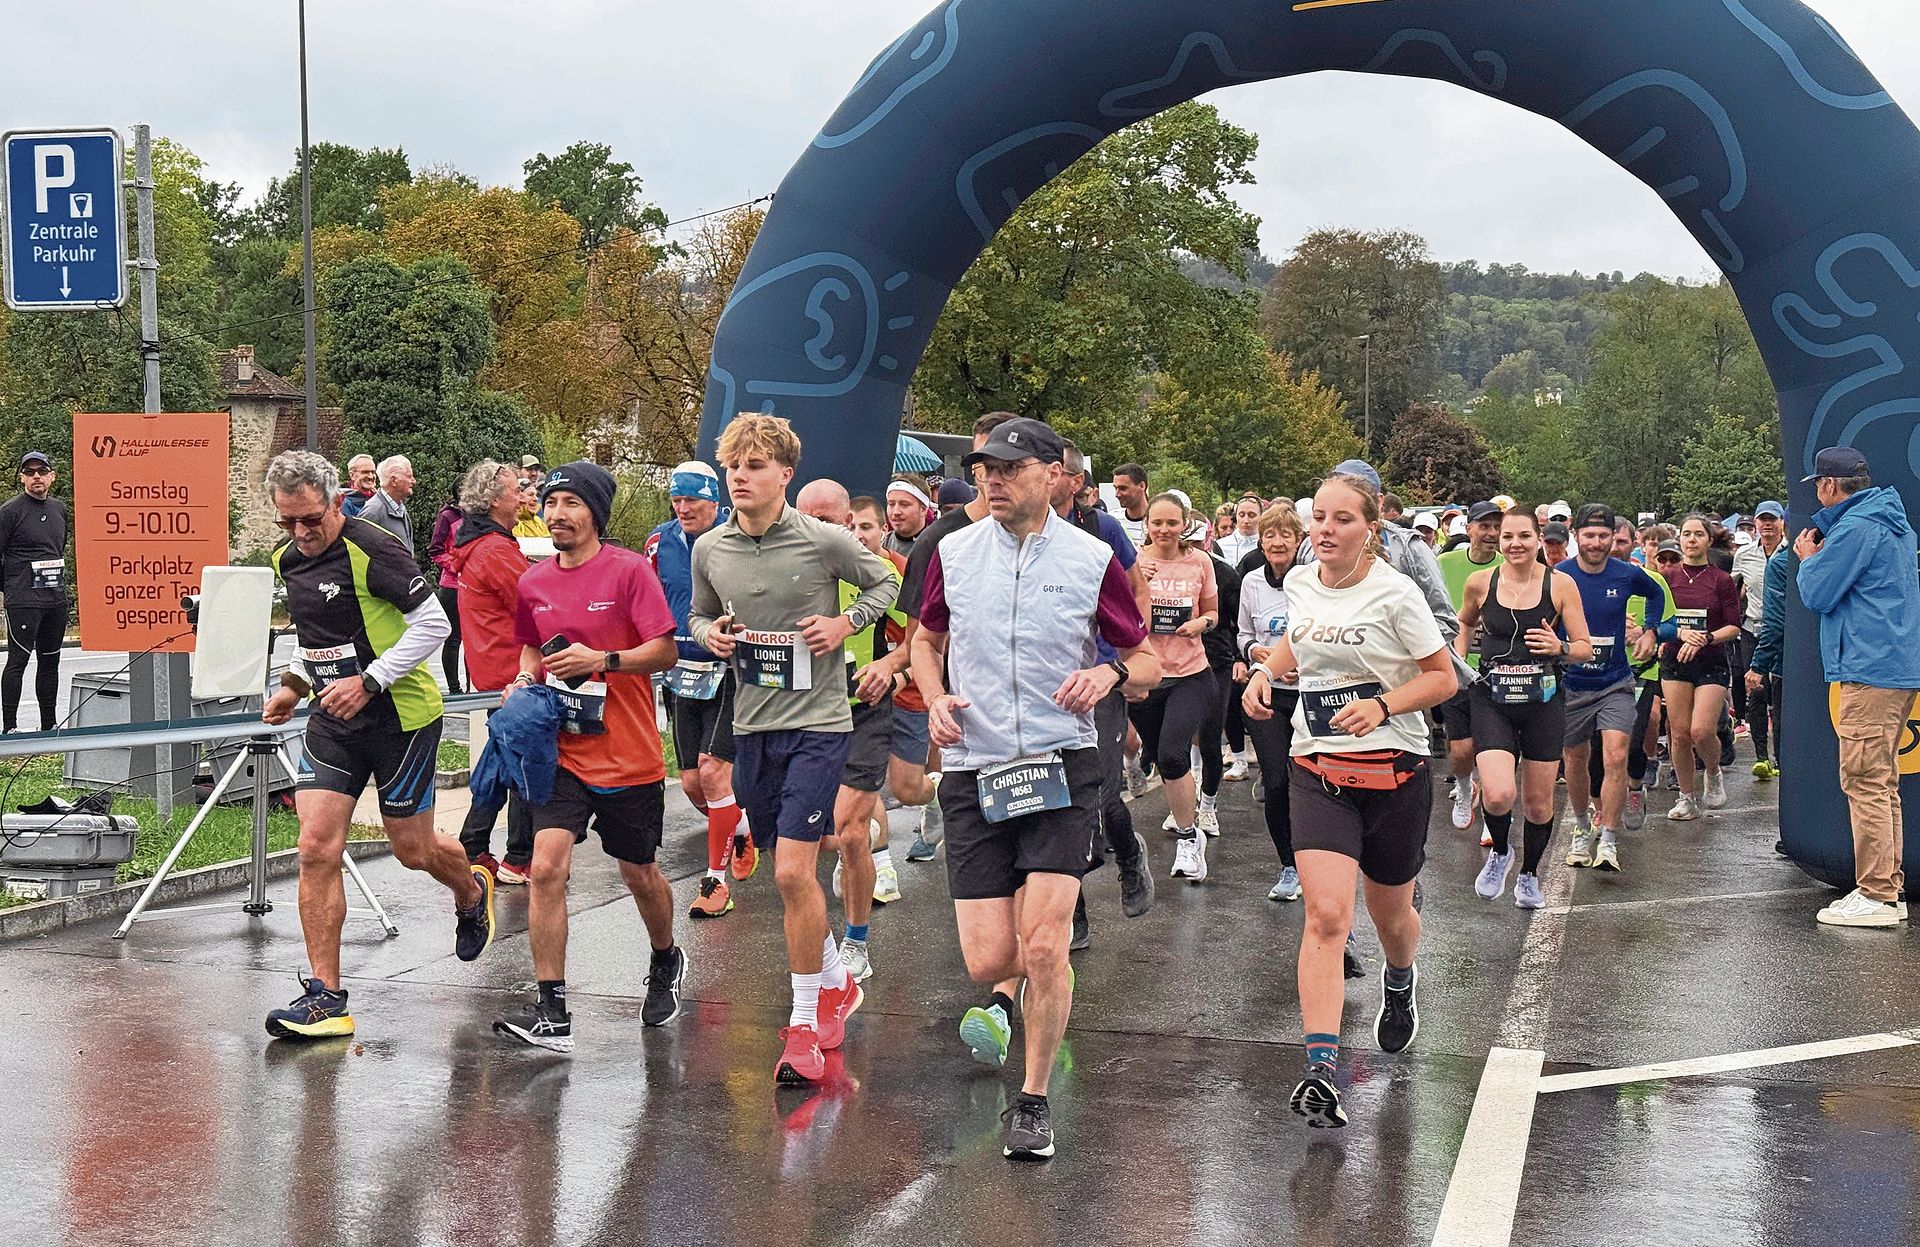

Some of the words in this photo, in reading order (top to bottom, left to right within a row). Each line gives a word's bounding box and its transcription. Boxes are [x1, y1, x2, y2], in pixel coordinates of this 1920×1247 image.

[34, 144, 76, 213] P
[29, 221, 99, 240] Zentrale
[33, 244, 97, 263] Parkuhr
[121, 439, 210, 448] HALLWILERSEE
[118, 449, 150, 457] LAUF
[110, 480, 189, 505] Samstag
[109, 554, 194, 581] Parkplatz
[104, 585, 166, 605] ganzer
[116, 609, 187, 630] gesperr
[745, 631, 795, 645] MIGROS
[754, 649, 788, 662] LIONEL
[314, 662, 340, 676] ANDRÉ
[1497, 665, 1535, 674] MIGROS
[1498, 676, 1533, 685] JEANNINE
[1320, 691, 1360, 707] MELINA
[992, 767, 1049, 791] CHRISTIAN
[1010, 784, 1033, 798] 10563
